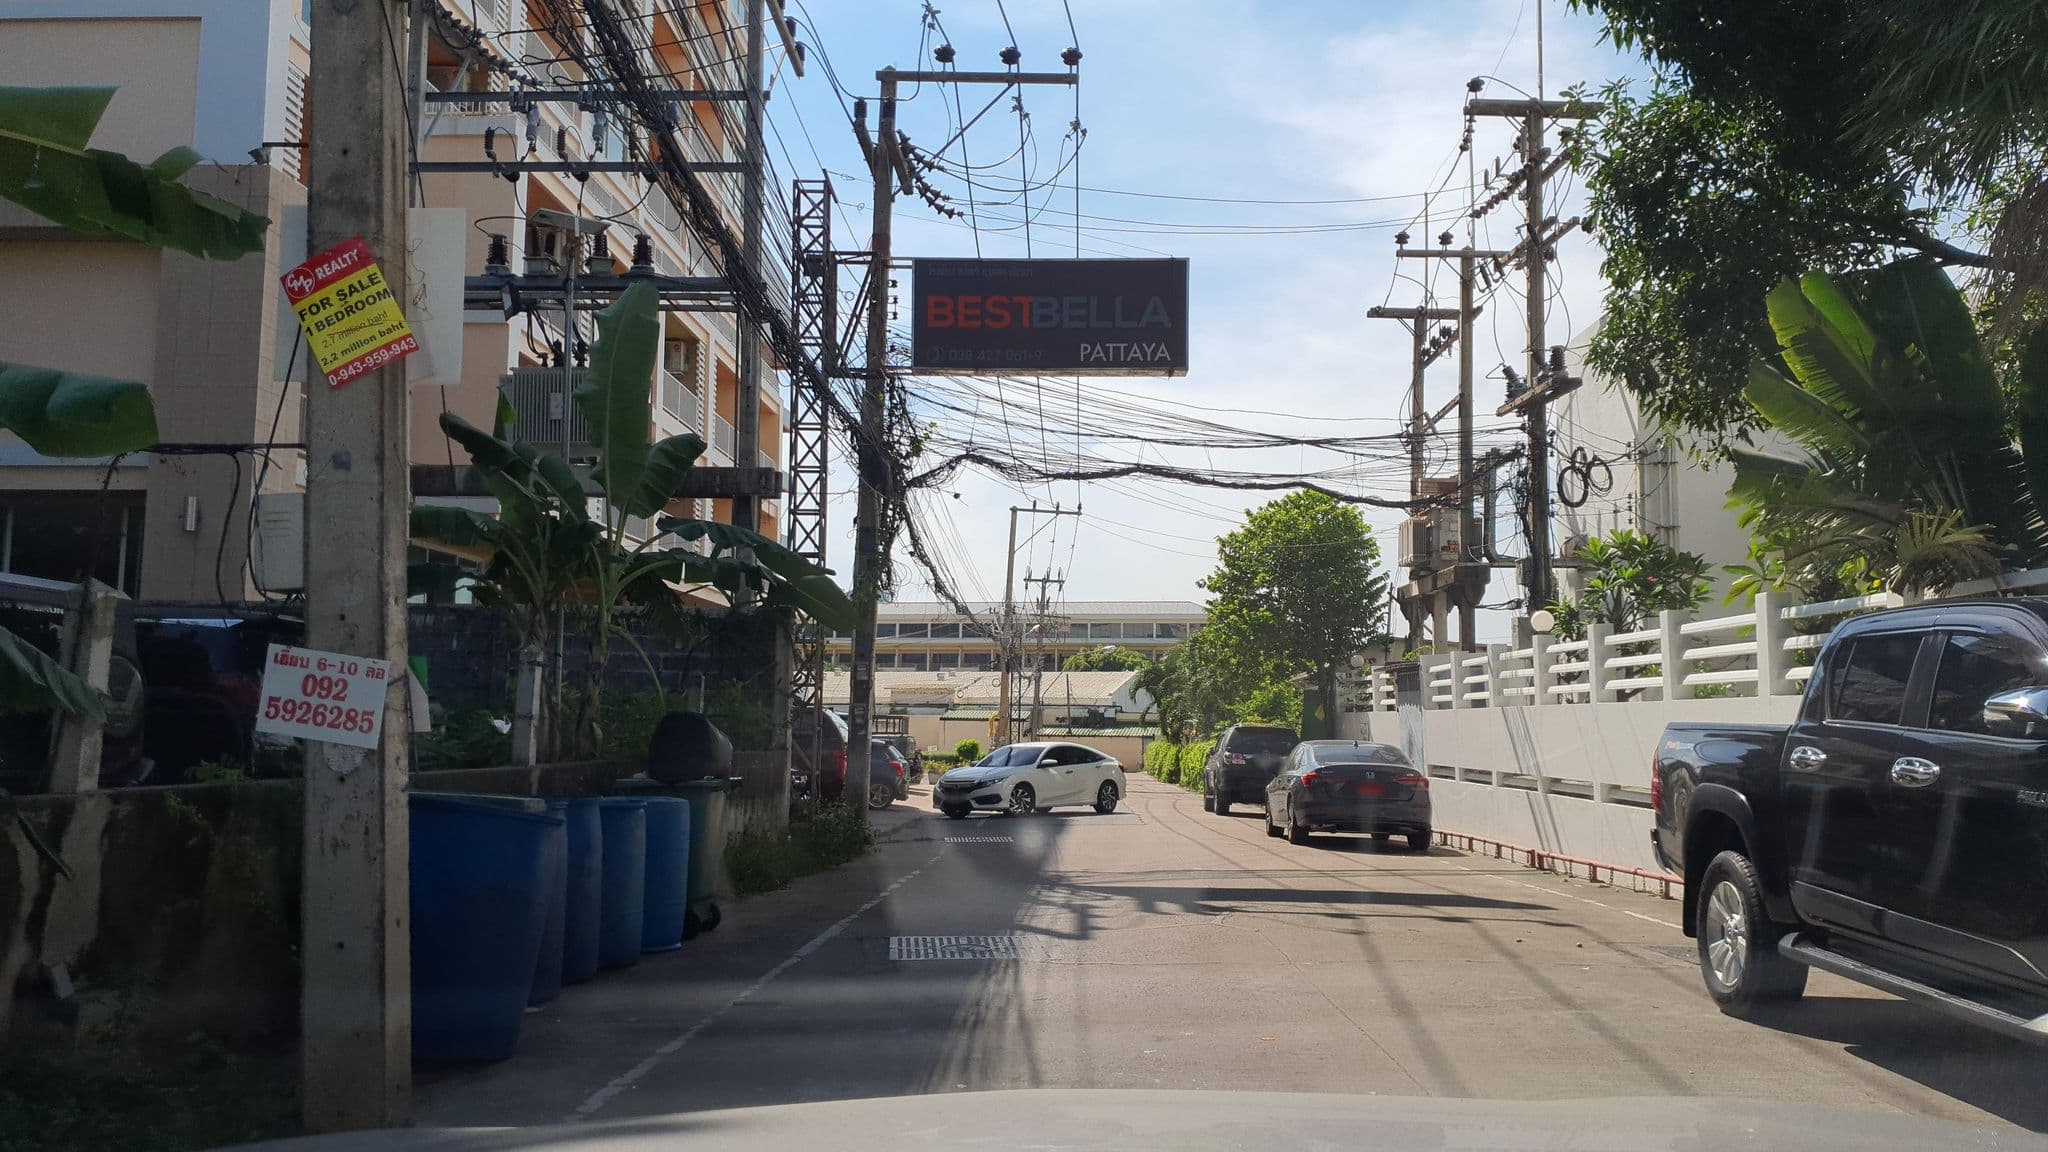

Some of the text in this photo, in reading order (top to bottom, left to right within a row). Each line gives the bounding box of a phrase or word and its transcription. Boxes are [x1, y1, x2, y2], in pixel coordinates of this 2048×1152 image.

[315, 249, 359, 280] REALTY
[298, 272, 382, 322] FOR SALE
[305, 288, 392, 337] 1 BEDROOM
[367, 311, 389, 327] baht
[340, 335, 377, 357] million
[378, 321, 405, 339] baht
[1080, 343, 1171, 362] PATTAYA
[328, 338, 417, 386] 0-943-959-943
[317, 657, 358, 676] 6-10
[301, 673, 349, 702] 092
[264, 695, 375, 735] 5926285
